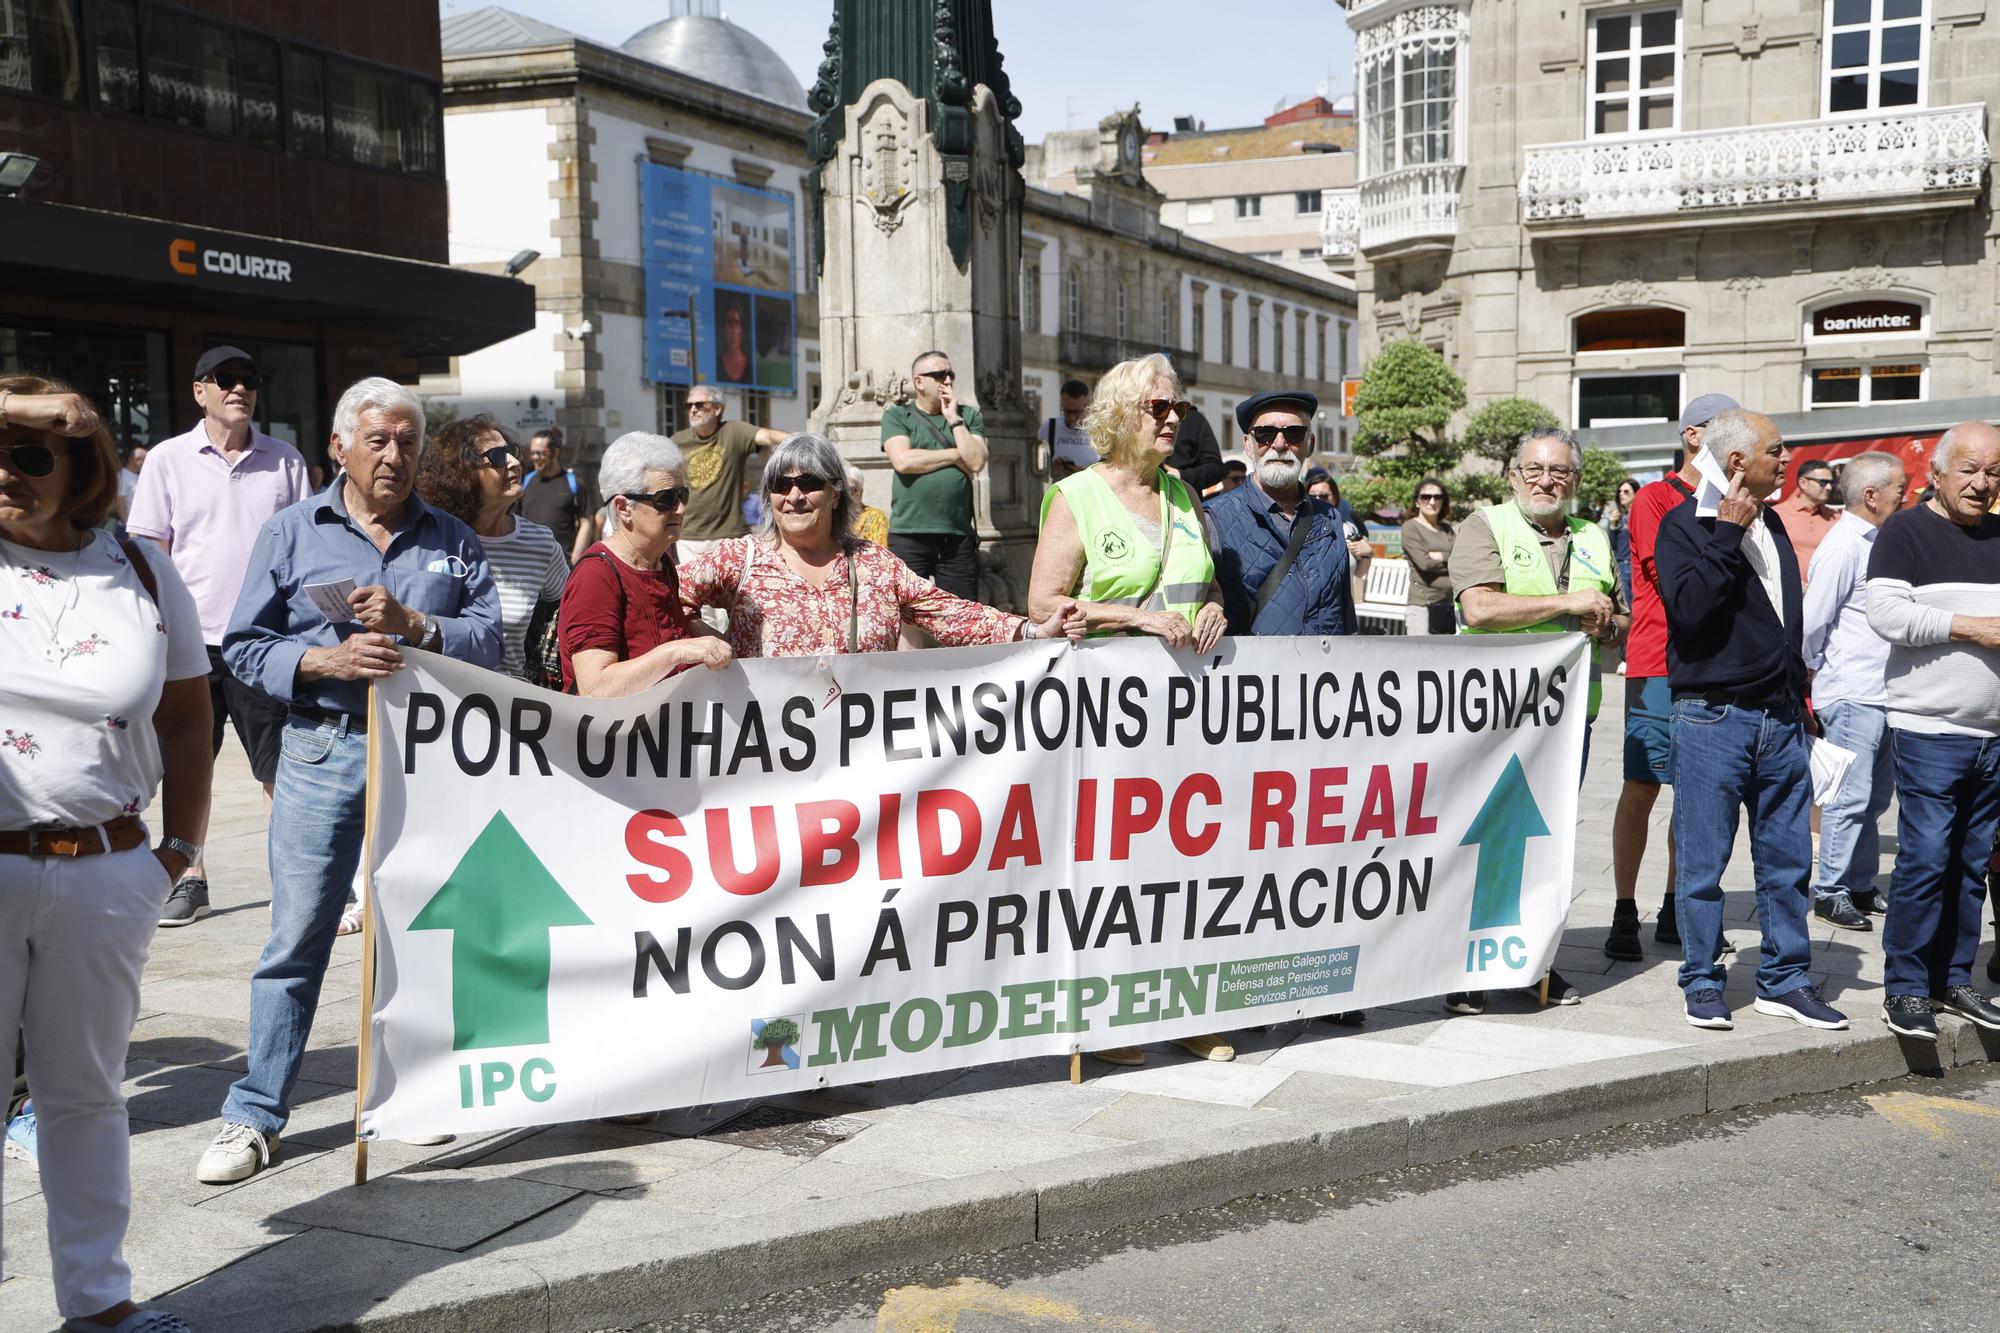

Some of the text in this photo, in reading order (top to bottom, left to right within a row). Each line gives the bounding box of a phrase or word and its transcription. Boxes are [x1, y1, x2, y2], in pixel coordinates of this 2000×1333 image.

[203, 249, 292, 282] COURIR
[404, 656, 1568, 778] POR UNHAS PENSIÓNS PÚBLICAS DIGNAS
[624, 762, 1438, 903] SUBIDA IPC REAL
[633, 846, 1434, 998] NON Á PRIVATIZACIÓN
[1230, 950, 1349, 976] Movemento Galego pola
[1465, 935, 1528, 973] IPC
[1222, 966, 1353, 993] Defensa das Pensións e os
[1243, 984, 1329, 1006] Servizos Públicos
[807, 962, 1219, 1068] MODEPEN
[458, 1057, 558, 1109] IPC
